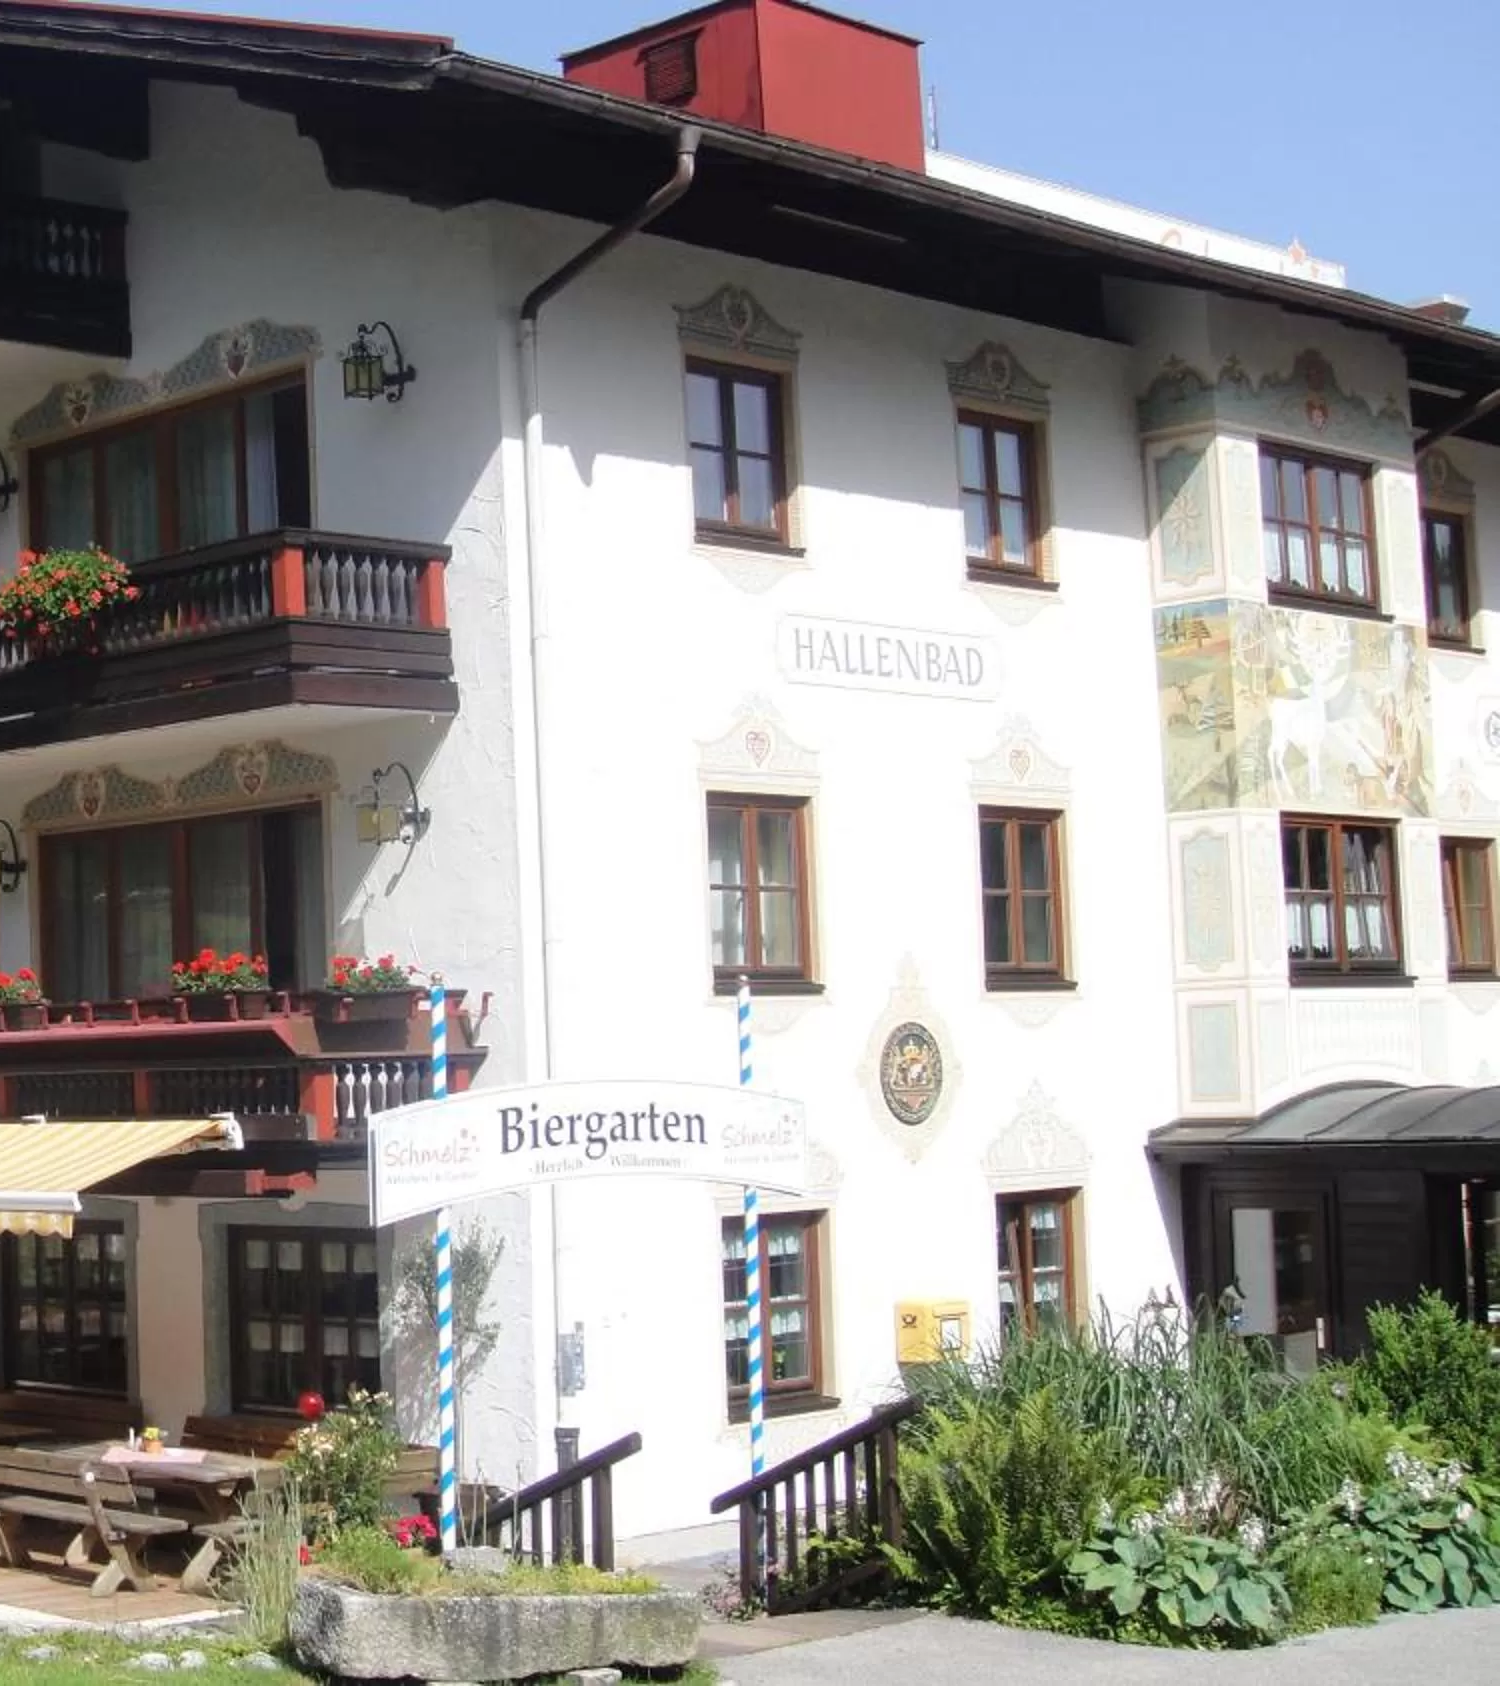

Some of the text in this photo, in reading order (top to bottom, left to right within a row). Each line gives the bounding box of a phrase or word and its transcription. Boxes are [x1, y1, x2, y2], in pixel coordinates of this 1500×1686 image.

[793, 626, 985, 687] HALLENBAD
[497, 1101, 709, 1160] Biergarten
[720, 1119, 794, 1149] Schmelz
[383, 1137, 473, 1167] Schmelz
[534, 1153, 682, 1175] Herzlich Willkommen
